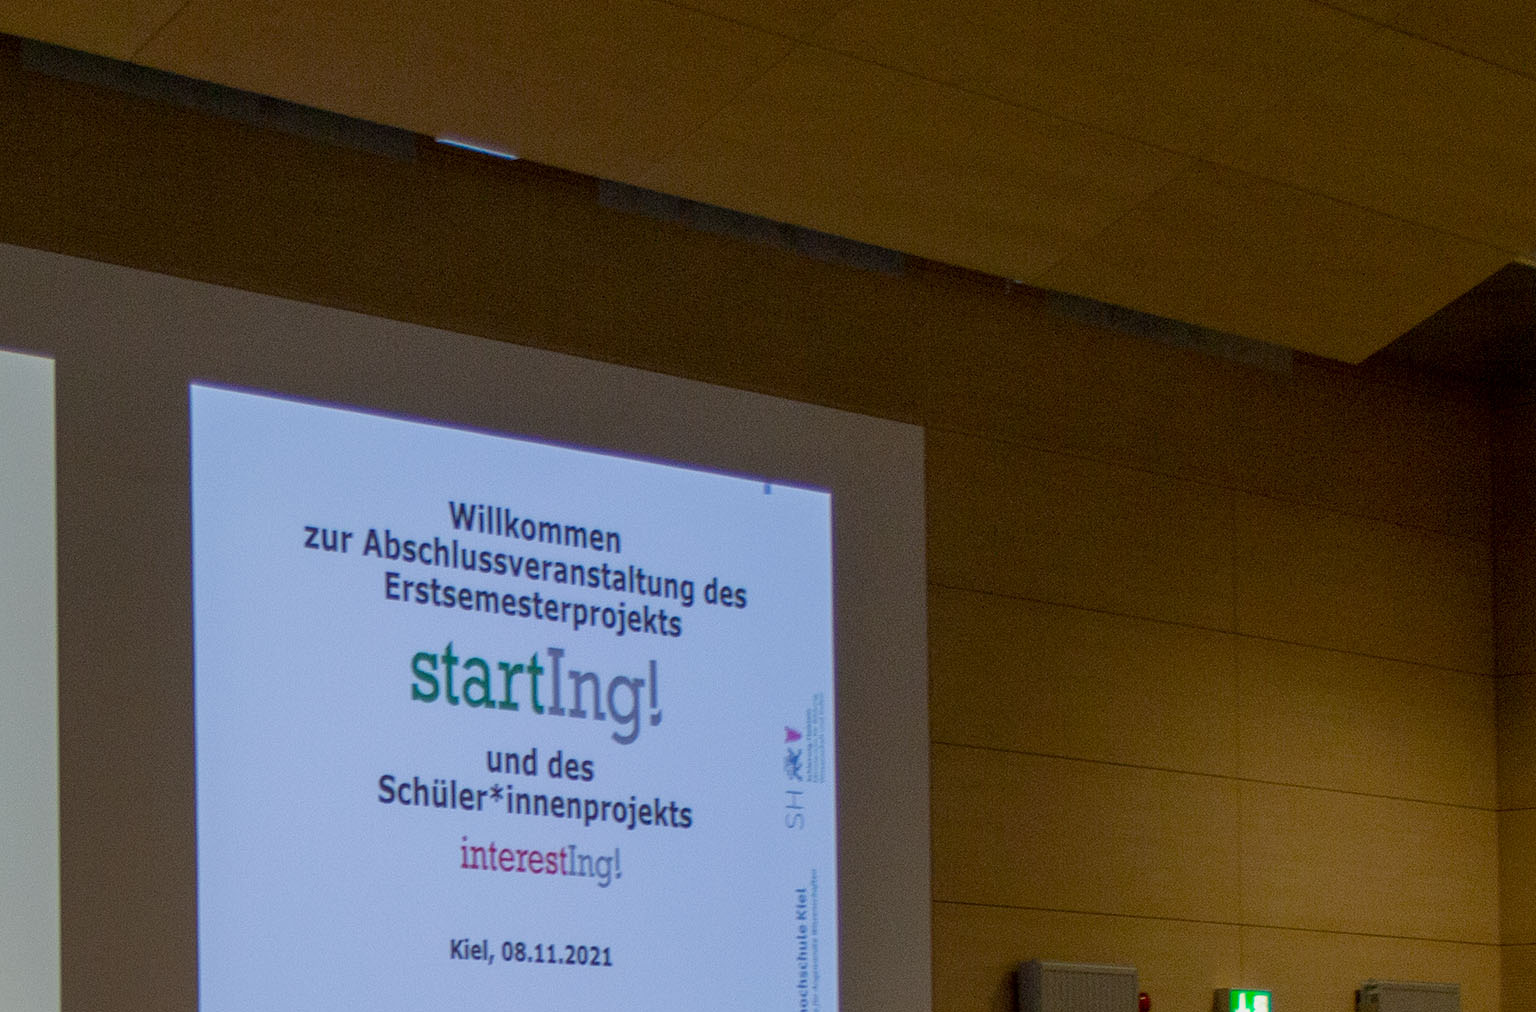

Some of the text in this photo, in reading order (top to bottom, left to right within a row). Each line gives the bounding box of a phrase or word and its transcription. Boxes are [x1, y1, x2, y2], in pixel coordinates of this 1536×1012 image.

[449, 500, 621, 553] Willkommen
[303, 525, 748, 608] zur Abschlussveranstaltung des
[384, 571, 682, 637] Erstsemesterprojekts
[410, 641, 663, 745] startIng!
[486, 748, 595, 783] und des
[785, 790, 805, 830] SH
[460, 836, 623, 889] interestIng!
[795, 888, 807, 921] Kiel
[450, 939, 614, 967] Kiel, 08.11.2021
